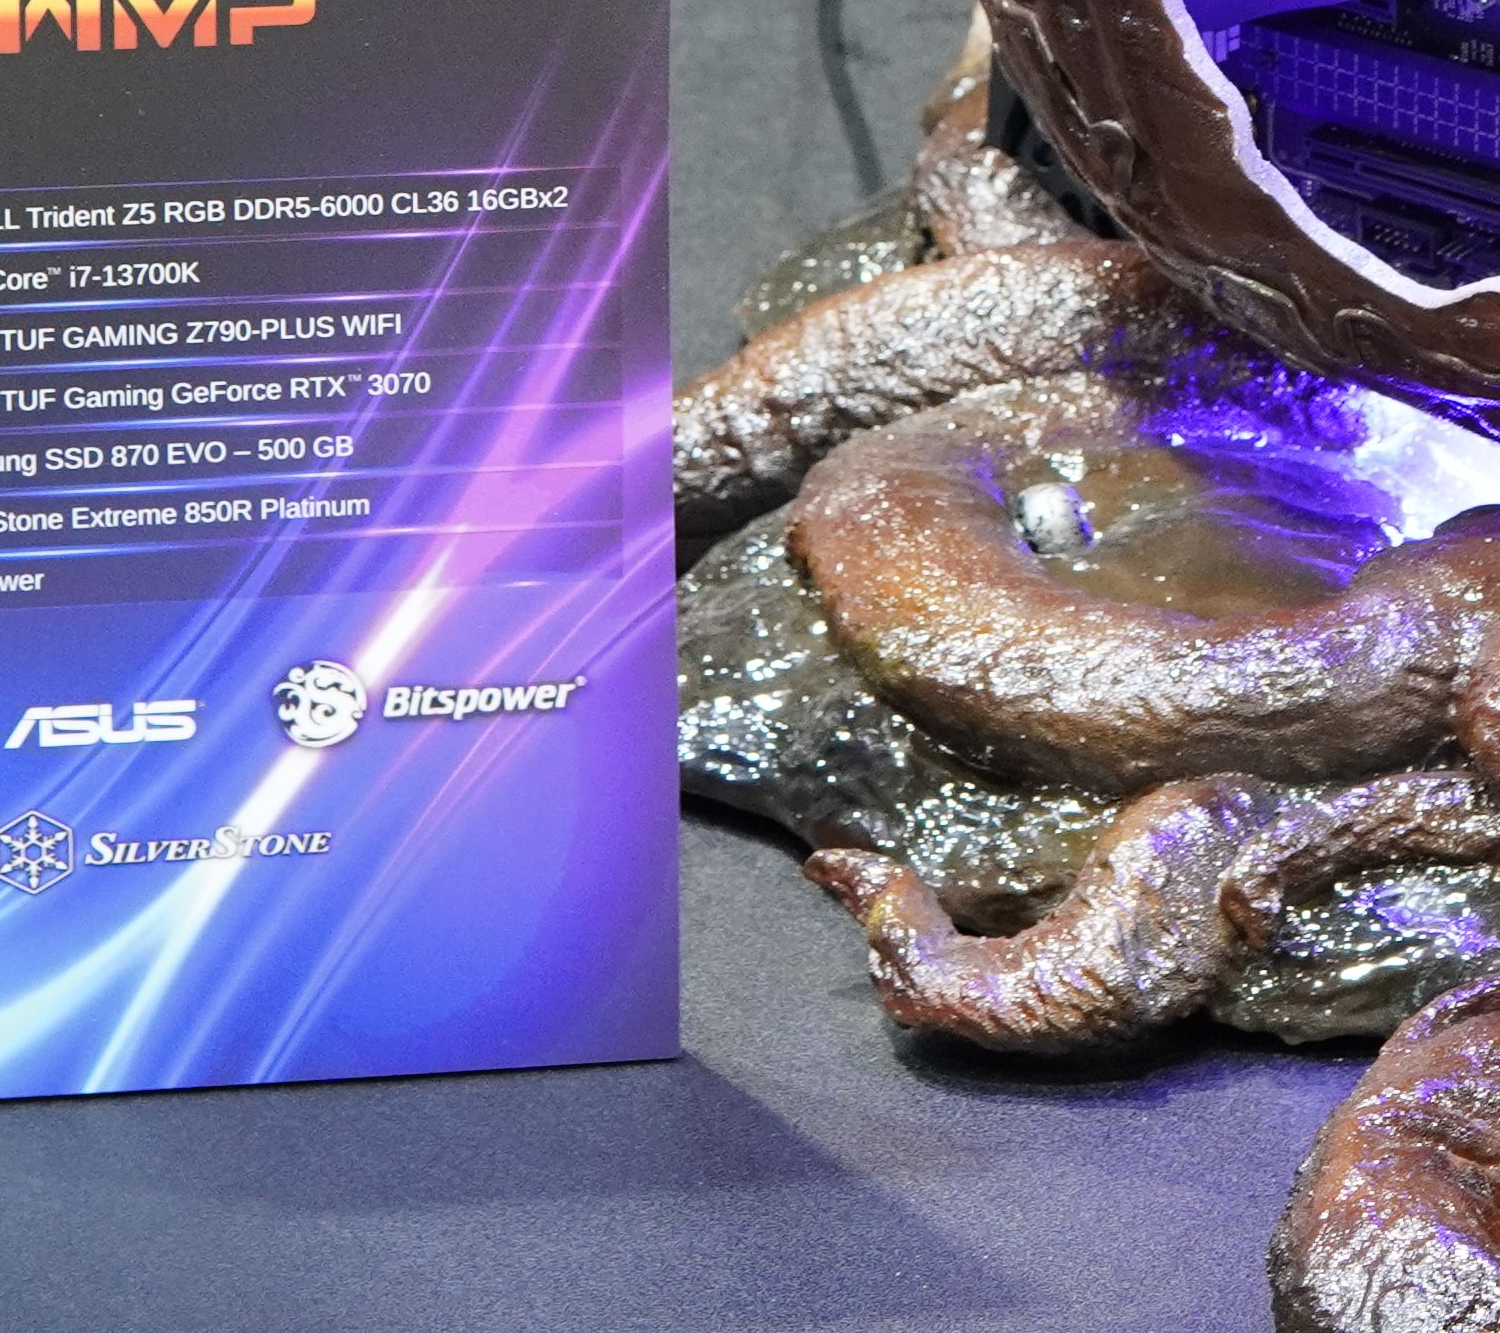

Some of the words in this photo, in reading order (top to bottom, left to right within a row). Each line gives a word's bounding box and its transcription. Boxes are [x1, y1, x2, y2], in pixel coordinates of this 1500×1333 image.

[26, 205, 115, 228] Trident
[122, 203, 156, 225] Z5
[165, 200, 225, 223] RGB
[235, 194, 383, 220] DDR5-6000
[391, 191, 458, 214] CL36
[468, 186, 568, 211] 16GBx2
[70, 262, 200, 287] i7-13700K
[0, 328, 55, 351] TUF
[63, 323, 178, 348] GAMING
[186, 316, 334, 343] Z790-PLUS
[342, 314, 401, 336] WIFI
[0, 389, 55, 411] TUF
[64, 384, 163, 410] Gaming
[172, 381, 282, 404] GeForce
[368, 372, 430, 395] 3070
[46, 447, 103, 470] SSD
[111, 444, 159, 467] 870
[168, 441, 226, 464] EVO
[259, 438, 305, 460] 500
[313, 436, 353, 457] GB
[72, 507, 177, 528] Extreme
[185, 500, 252, 523] 850R
[261, 496, 369, 519] Platinum
[4, 699, 197, 751] ASUS
